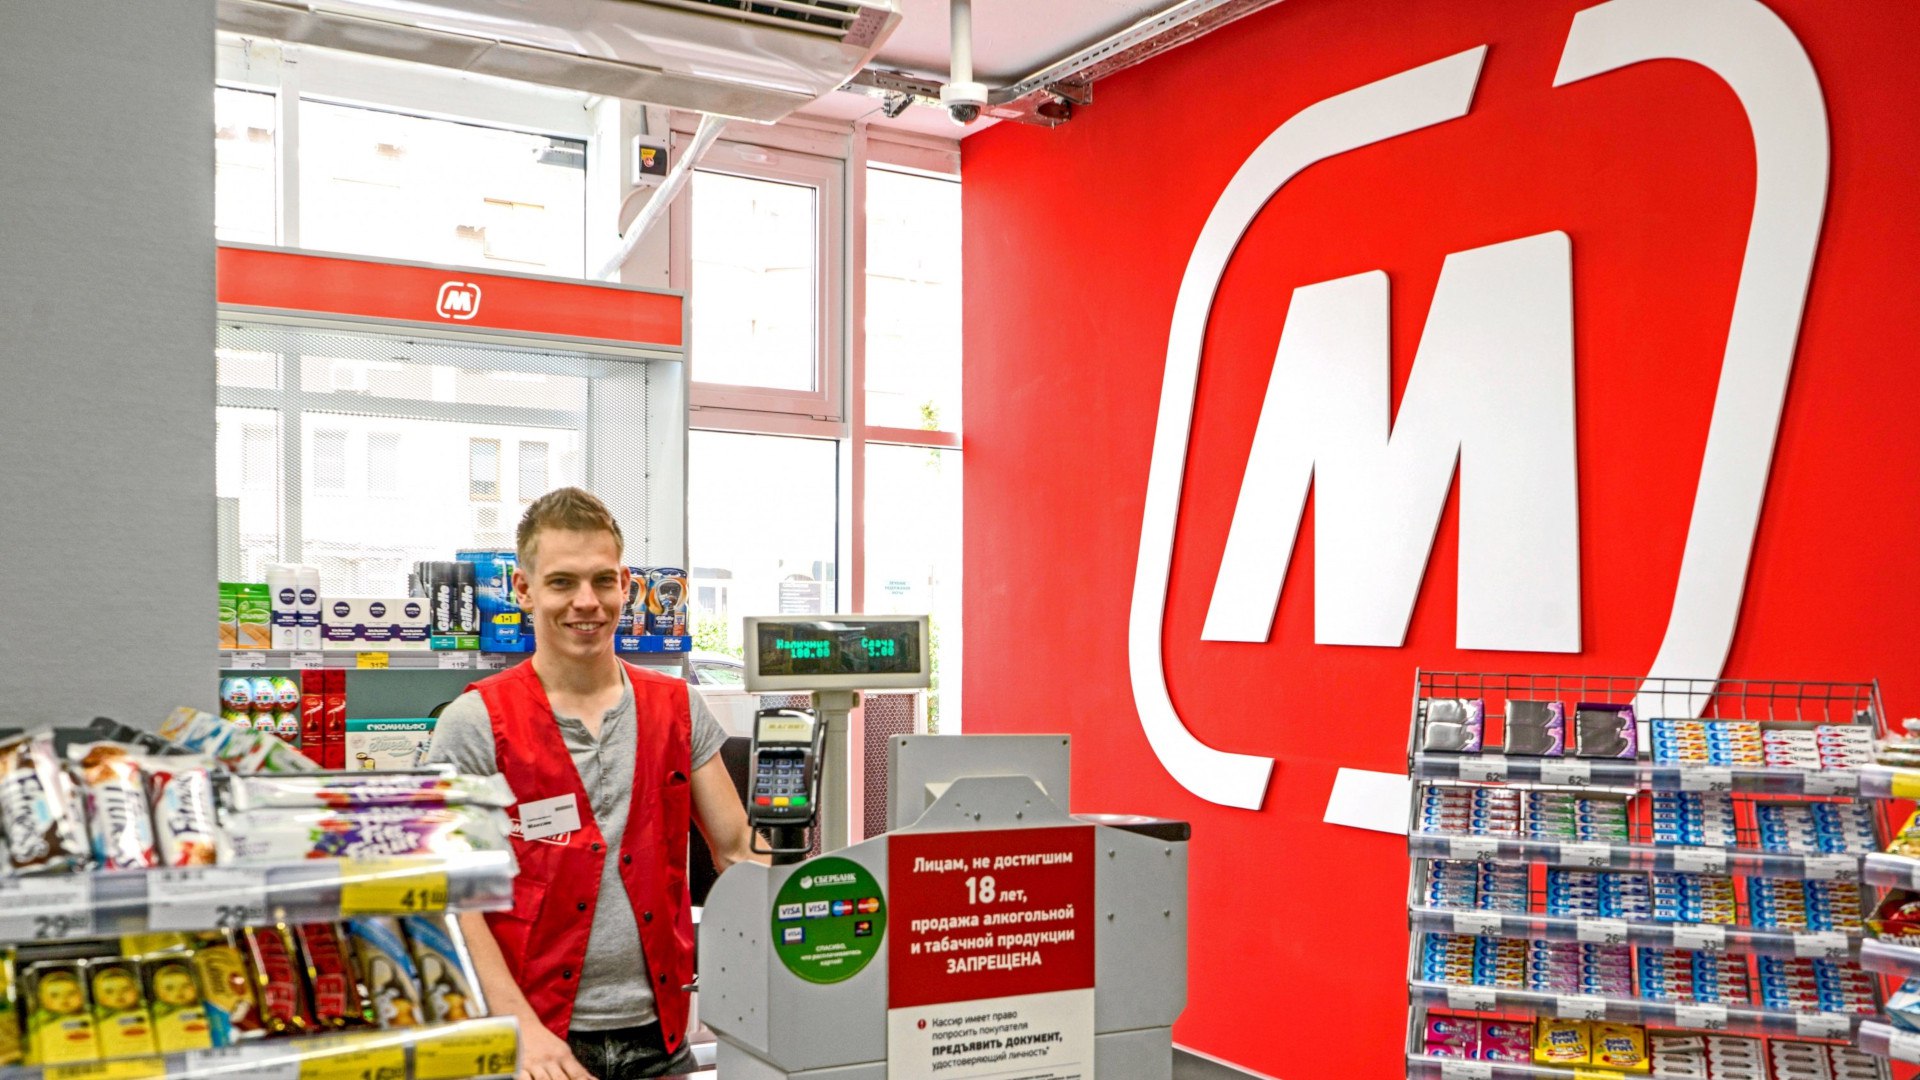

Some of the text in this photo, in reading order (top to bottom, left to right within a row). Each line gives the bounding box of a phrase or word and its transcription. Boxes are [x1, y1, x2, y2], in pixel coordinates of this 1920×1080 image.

[436, 585, 450, 632] Gillette
[460, 585, 474, 632] Gillette
[501, 615, 513, 623] 1+1
[791, 648, 895, 659] 100.00 3.00
[1485, 772, 1499, 782] 62
[1568, 775, 1583, 785] 62
[1710, 781, 1725, 792] 26
[1477, 850, 1491, 860] 26
[1588, 856, 1603, 866] 26
[913, 852, 1073, 873] Лицам, не достигшим
[1703, 863, 1719, 873] 33
[814, 873, 856, 884] СБЕРБАНК
[965, 875, 1028, 905] 18 лет,
[401, 890, 429, 911] 41
[782, 906, 801, 916] VISA
[808, 904, 827, 913] VISA
[215, 905, 245, 928] 29
[911, 904, 1075, 935] продажа алкогольной
[35, 914, 70, 939] 29
[1480, 925, 1495, 935] 26
[911, 929, 1075, 955] и табачной продукции
[1605, 933, 1620, 943] 26
[1702, 940, 1717, 950] 33
[946, 951, 1042, 974] ЗАПРЕЩЕНА
[1474, 1001, 1489, 1011] 26
[932, 1011, 1018, 1028] Кассир имеет право
[1585, 1010, 1599, 1020] 26
[1704, 1019, 1720, 1029] 26
[932, 1021, 1028, 1041] попросить покупателя
[932, 1032, 1063, 1056] ПРЕДЪЯВИТЬ ДОКУМЕНТ,
[474, 1054, 499, 1074] 16
[932, 1053, 1007, 1072] удостоверяющий
